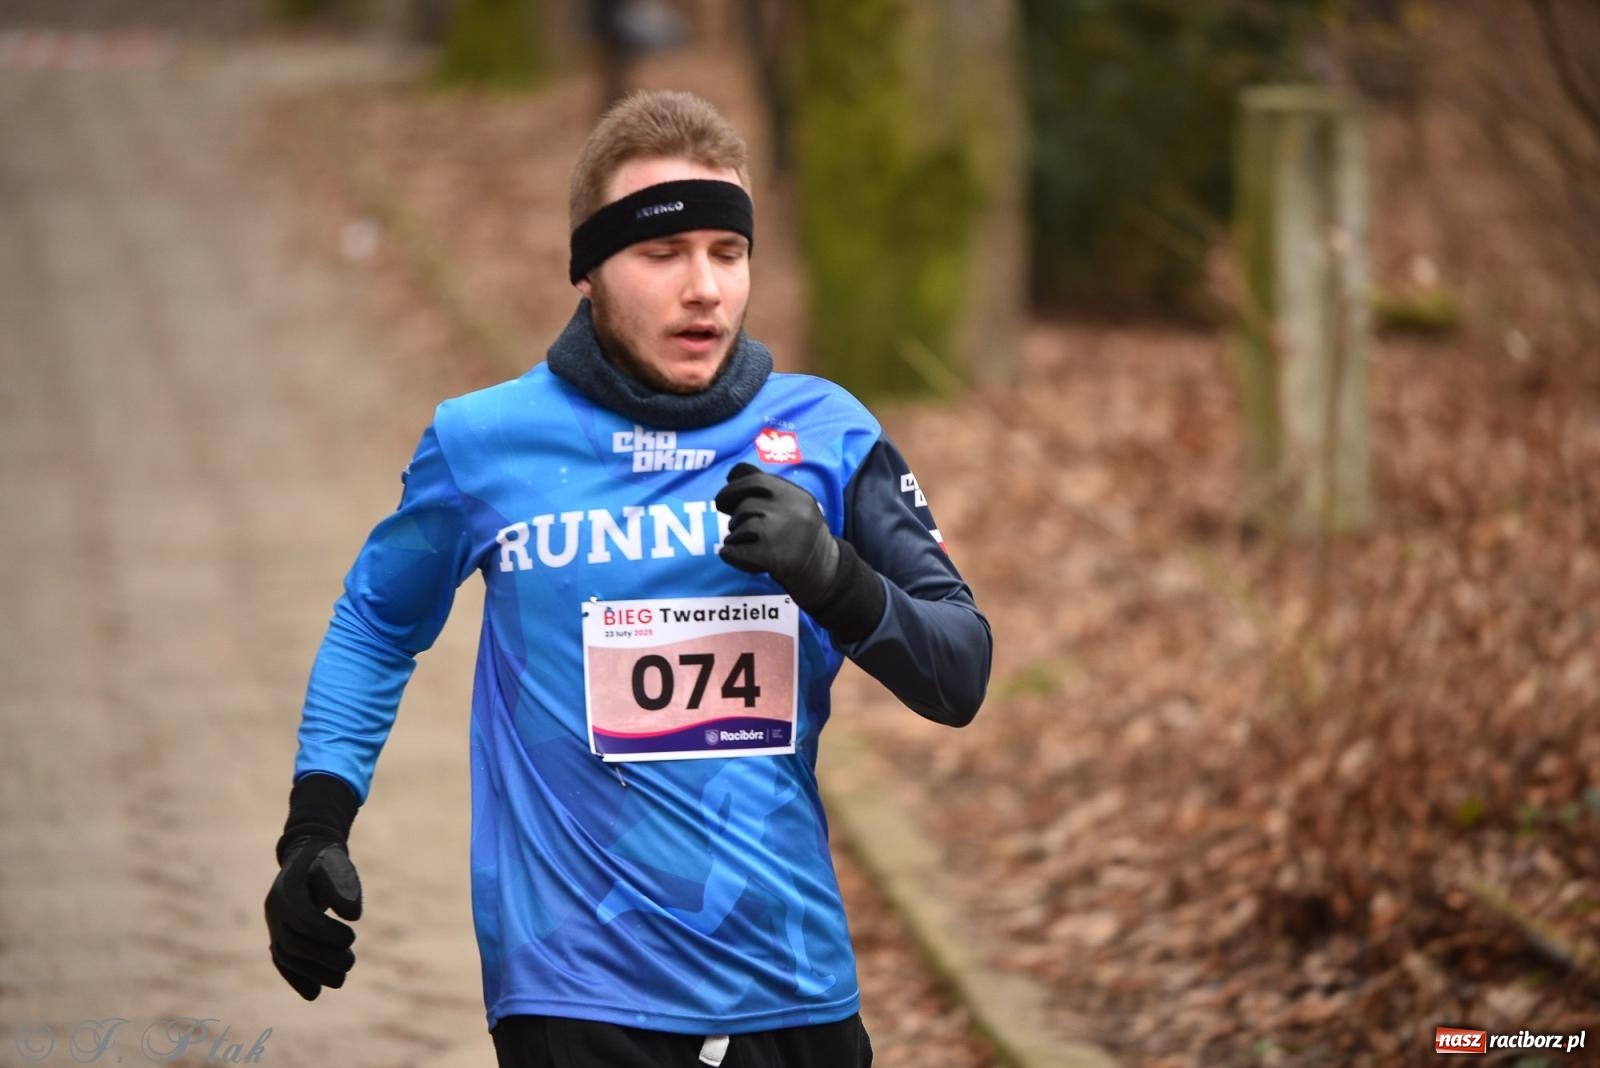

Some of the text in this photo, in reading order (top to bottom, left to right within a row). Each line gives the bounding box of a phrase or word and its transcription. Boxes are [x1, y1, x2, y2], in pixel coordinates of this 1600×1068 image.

[496, 500, 825, 573] RUNN
[604, 602, 780, 625] BIEG Twardziela
[631, 652, 761, 712] 074
[720, 729, 764, 742] Racibórz
